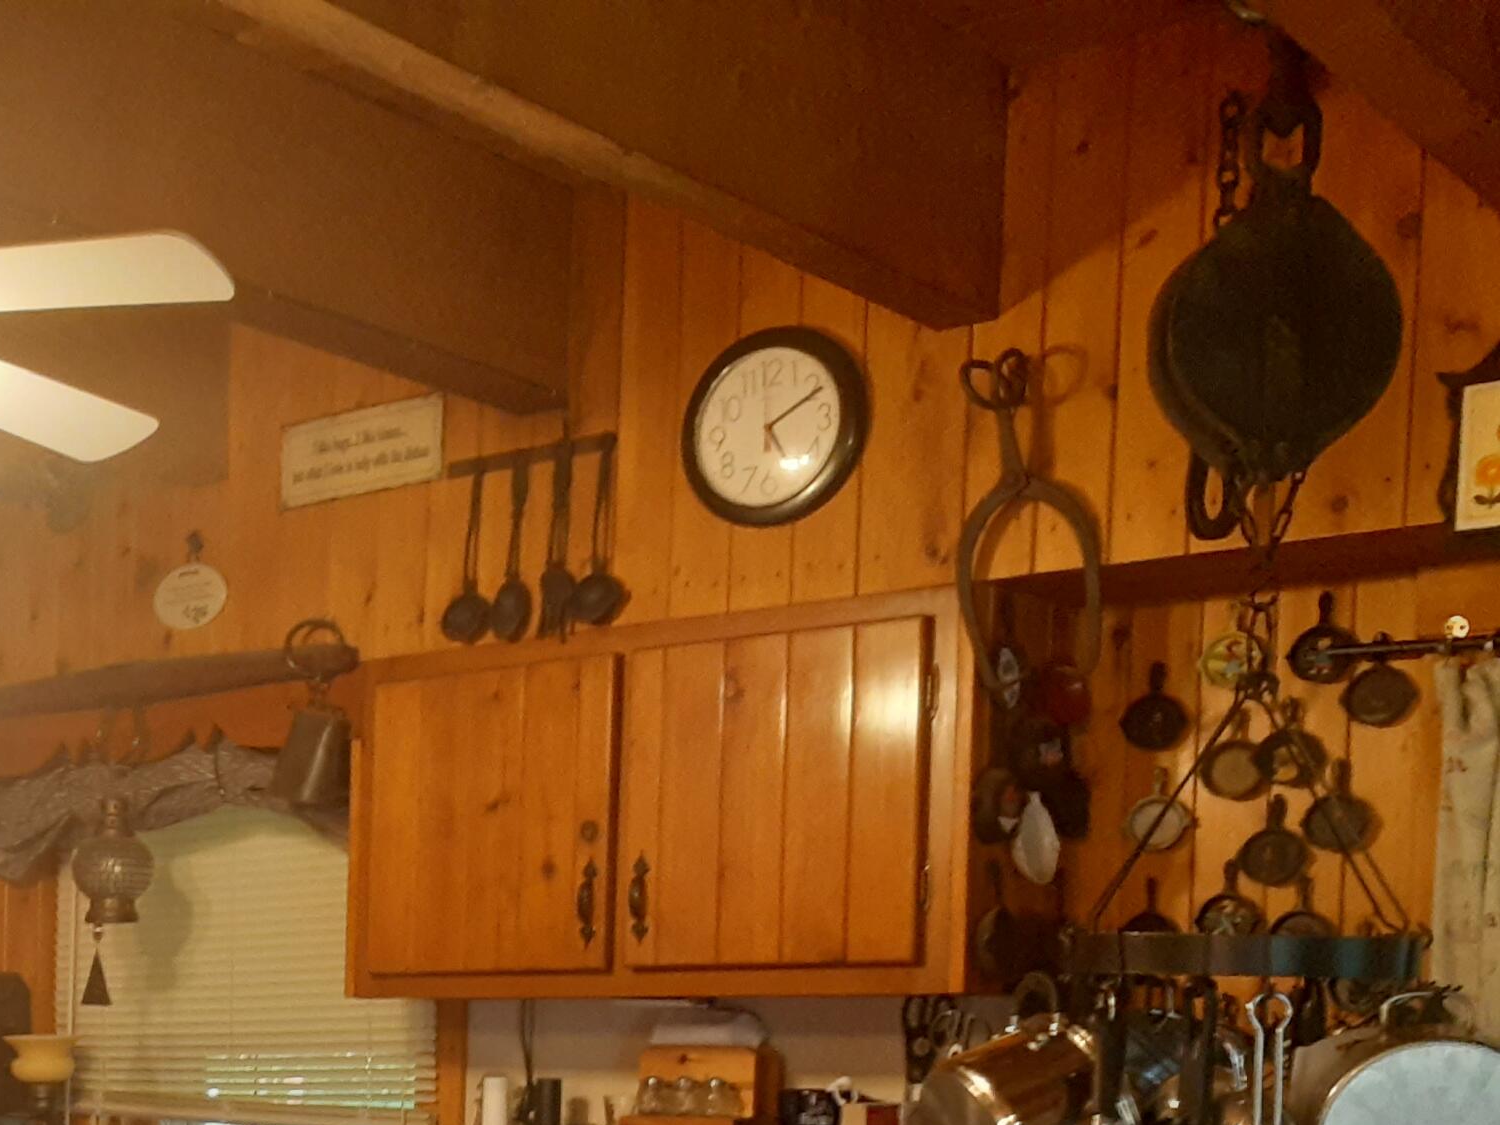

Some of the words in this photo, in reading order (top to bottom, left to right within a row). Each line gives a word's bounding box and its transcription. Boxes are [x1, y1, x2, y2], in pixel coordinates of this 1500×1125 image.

[741, 370, 758, 397] 11
[760, 357, 784, 388] 12
[790, 360, 798, 387] 1
[803, 374, 822, 401] 2
[721, 395, 742, 423] 10
[817, 403, 833, 432] 3
[708, 425, 727, 452] 9
[720, 453, 735, 479] 8
[741, 466, 758, 495] 7
[760, 470, 779, 496] 6
